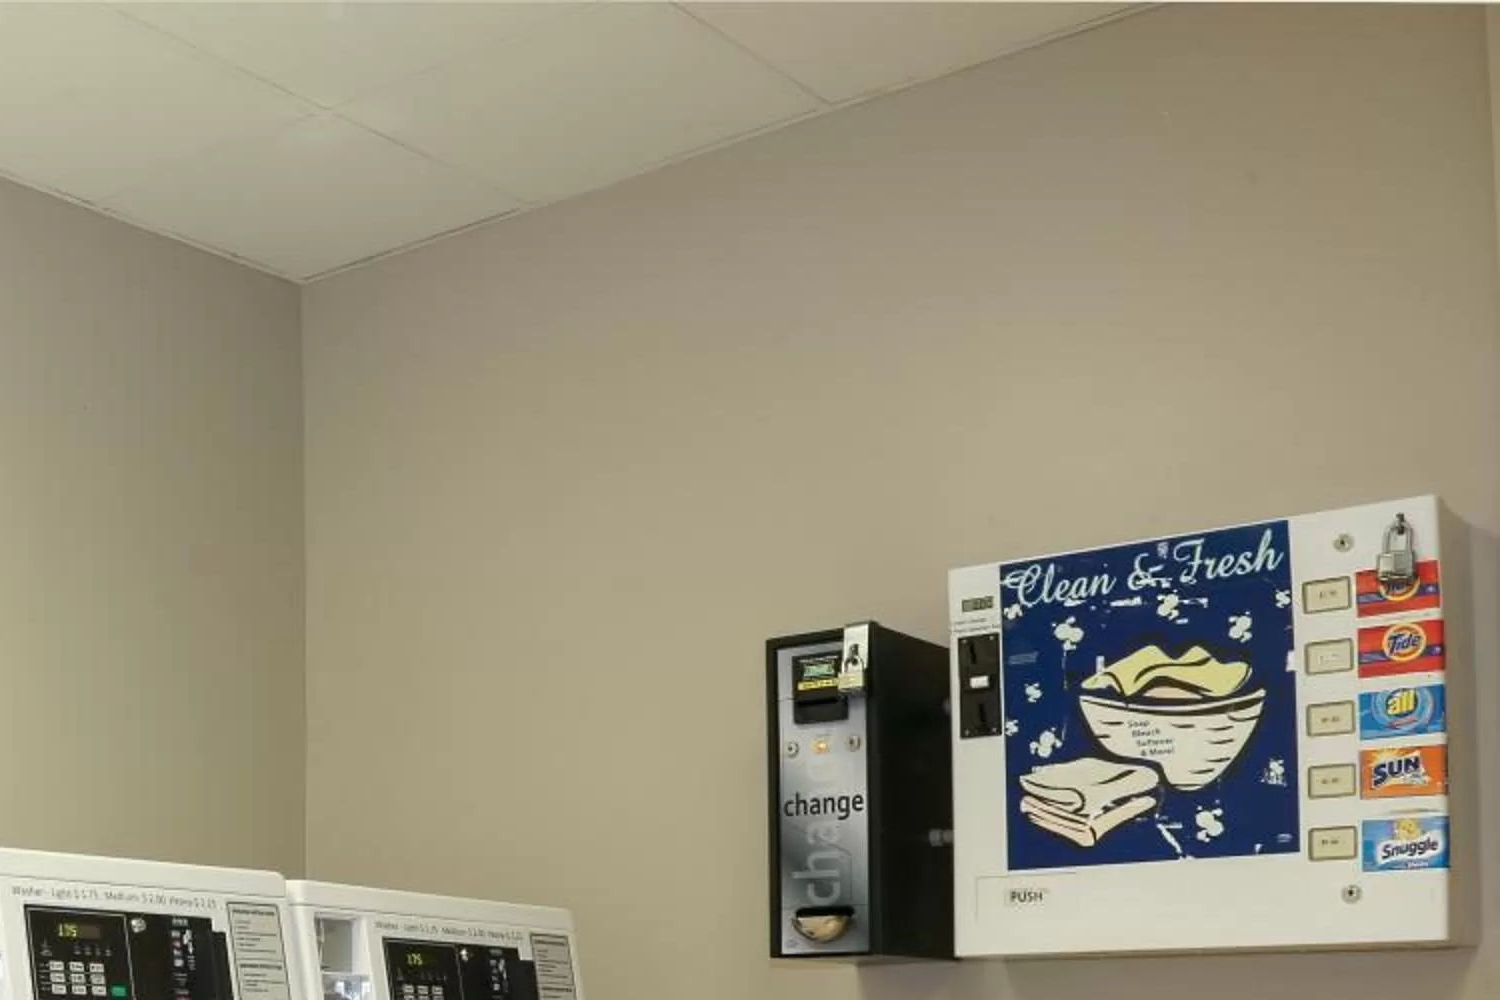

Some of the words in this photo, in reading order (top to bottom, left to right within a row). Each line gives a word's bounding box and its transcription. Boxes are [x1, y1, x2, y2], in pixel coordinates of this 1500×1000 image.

[1001, 563, 1117, 606] Clean
[1127, 553, 1164, 590] &
[1173, 528, 1285, 583] Fresh
[1387, 633, 1421, 655] Tide
[1387, 688, 1416, 715] all
[1373, 756, 1420, 787] SUN
[784, 791, 865, 820] change
[1381, 838, 1439, 860] Snuggle
[1010, 891, 1043, 903] PUSH
